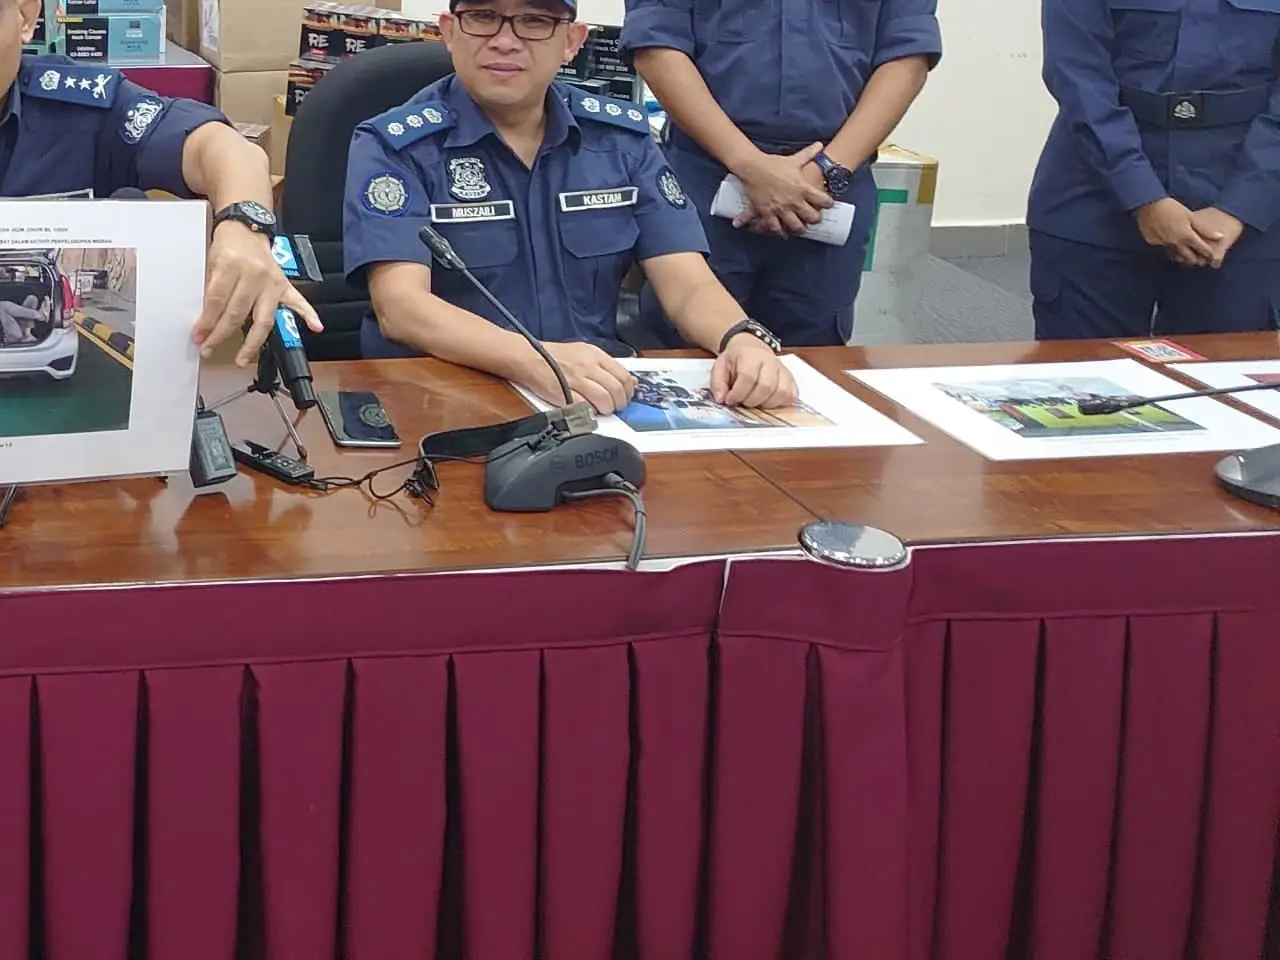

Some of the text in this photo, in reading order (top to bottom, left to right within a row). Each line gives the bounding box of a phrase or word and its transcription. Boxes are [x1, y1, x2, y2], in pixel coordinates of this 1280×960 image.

[308, 33, 329, 48] RE
[583, 193, 622, 206] KASTAM
[575, 448, 619, 470] BOSCH
